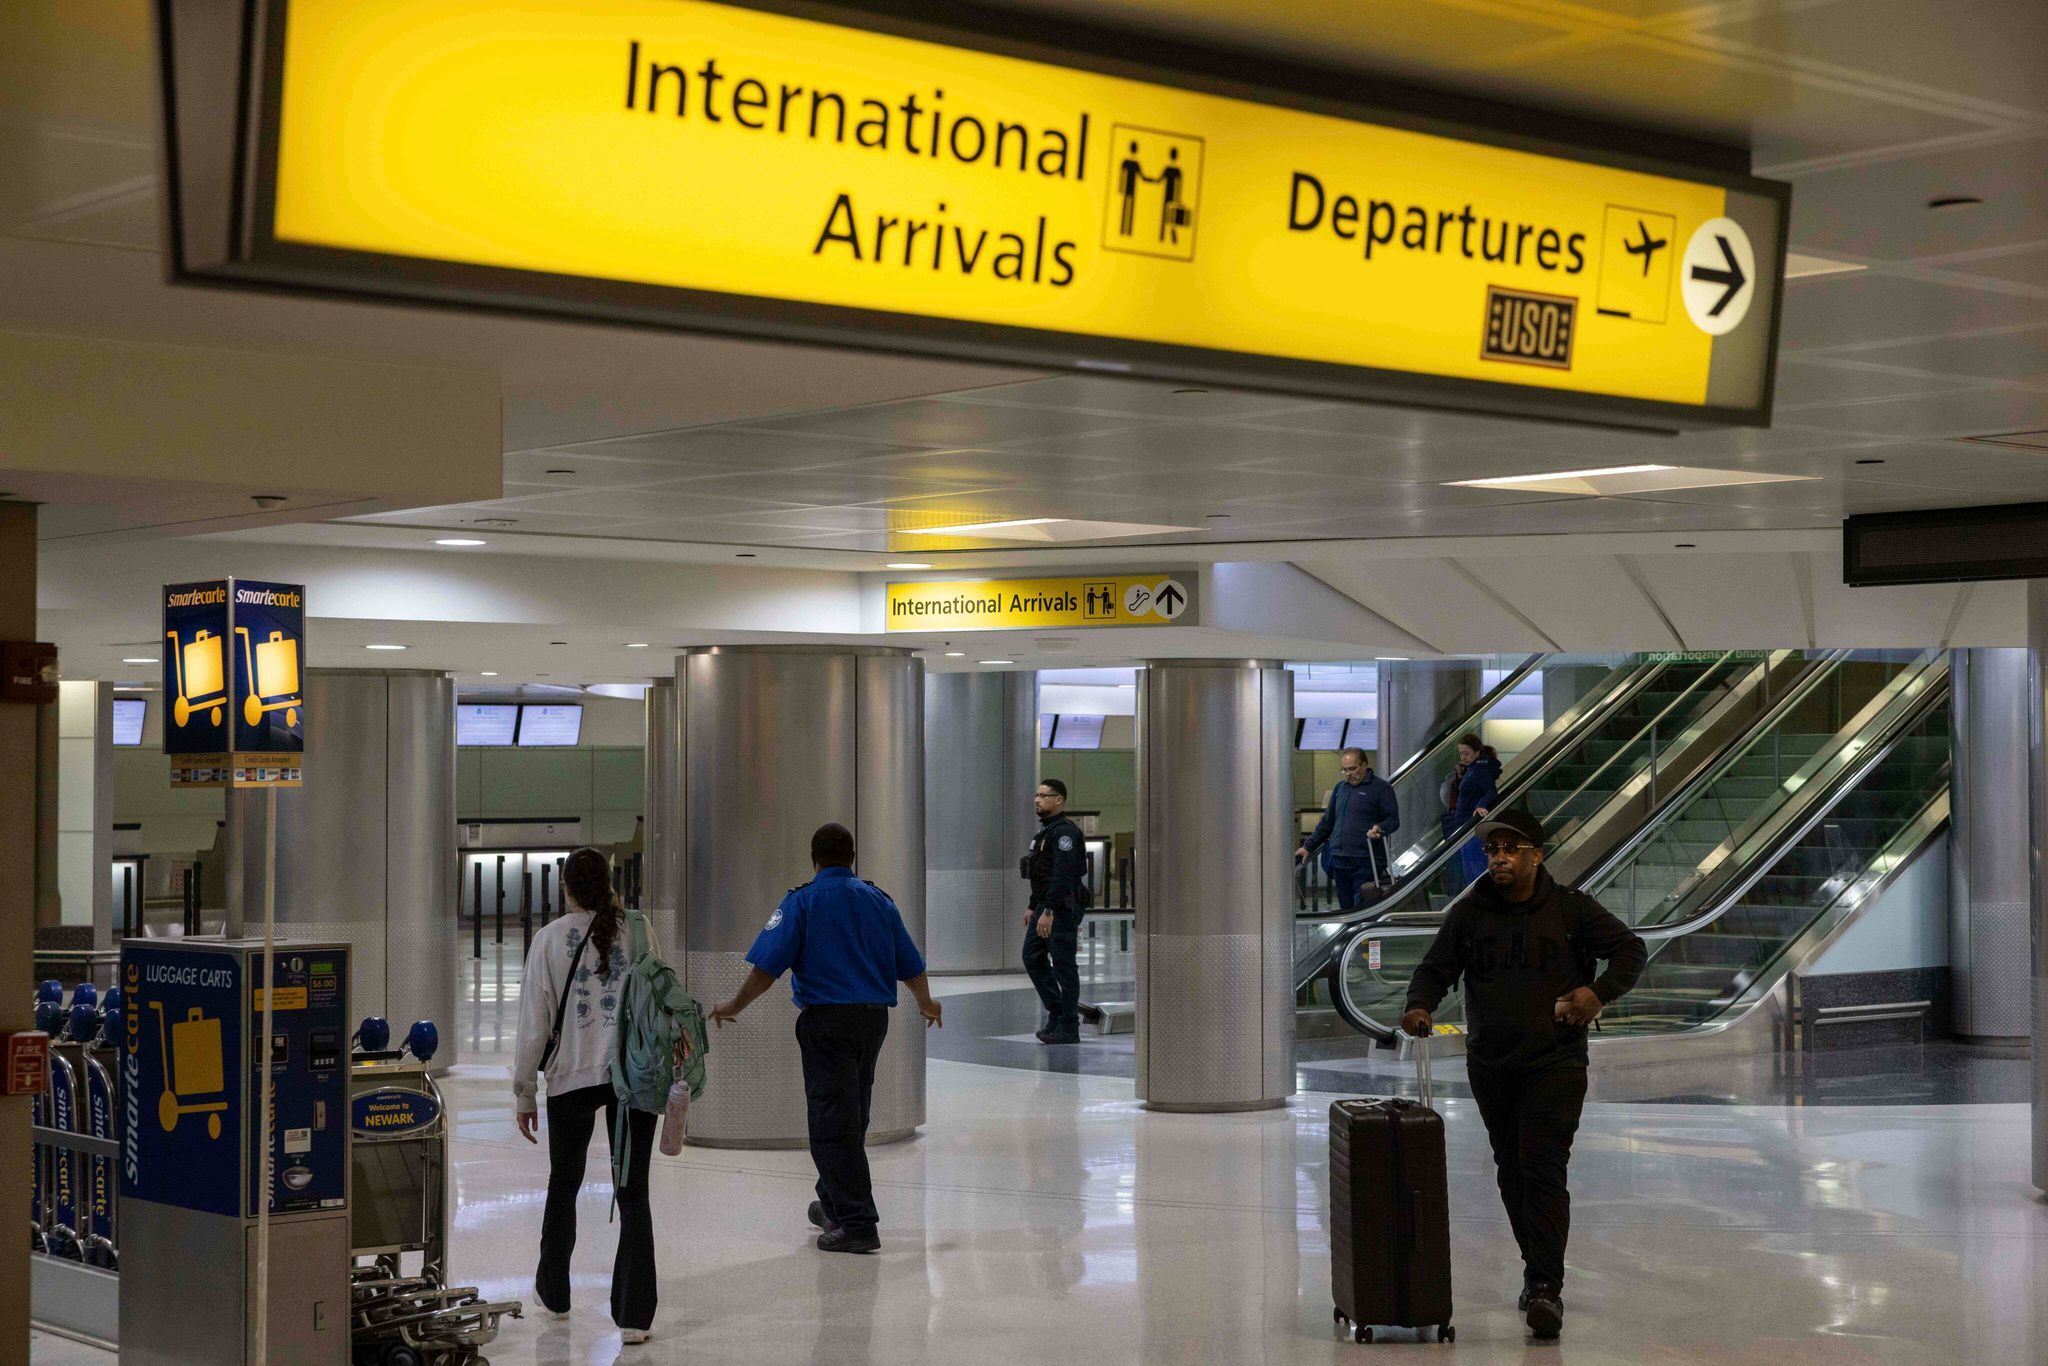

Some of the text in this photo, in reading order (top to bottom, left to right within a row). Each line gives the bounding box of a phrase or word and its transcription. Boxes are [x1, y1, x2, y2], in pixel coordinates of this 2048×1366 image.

[626, 41, 1090, 181] International
[813, 193, 1078, 287] Arrivals
[1288, 170, 1586, 274] Departures
[1500, 298, 1559, 358] USO
[892, 591, 1078, 616] International Arrivals
[146, 964, 233, 989] LUGGAGE CARTS
[365, 1112, 416, 1127] NEWARK
[368, 1102, 410, 1112] Welcome to
[57, 1086, 72, 1207] smaecarte
[93, 1094, 107, 1217] smaecarte
